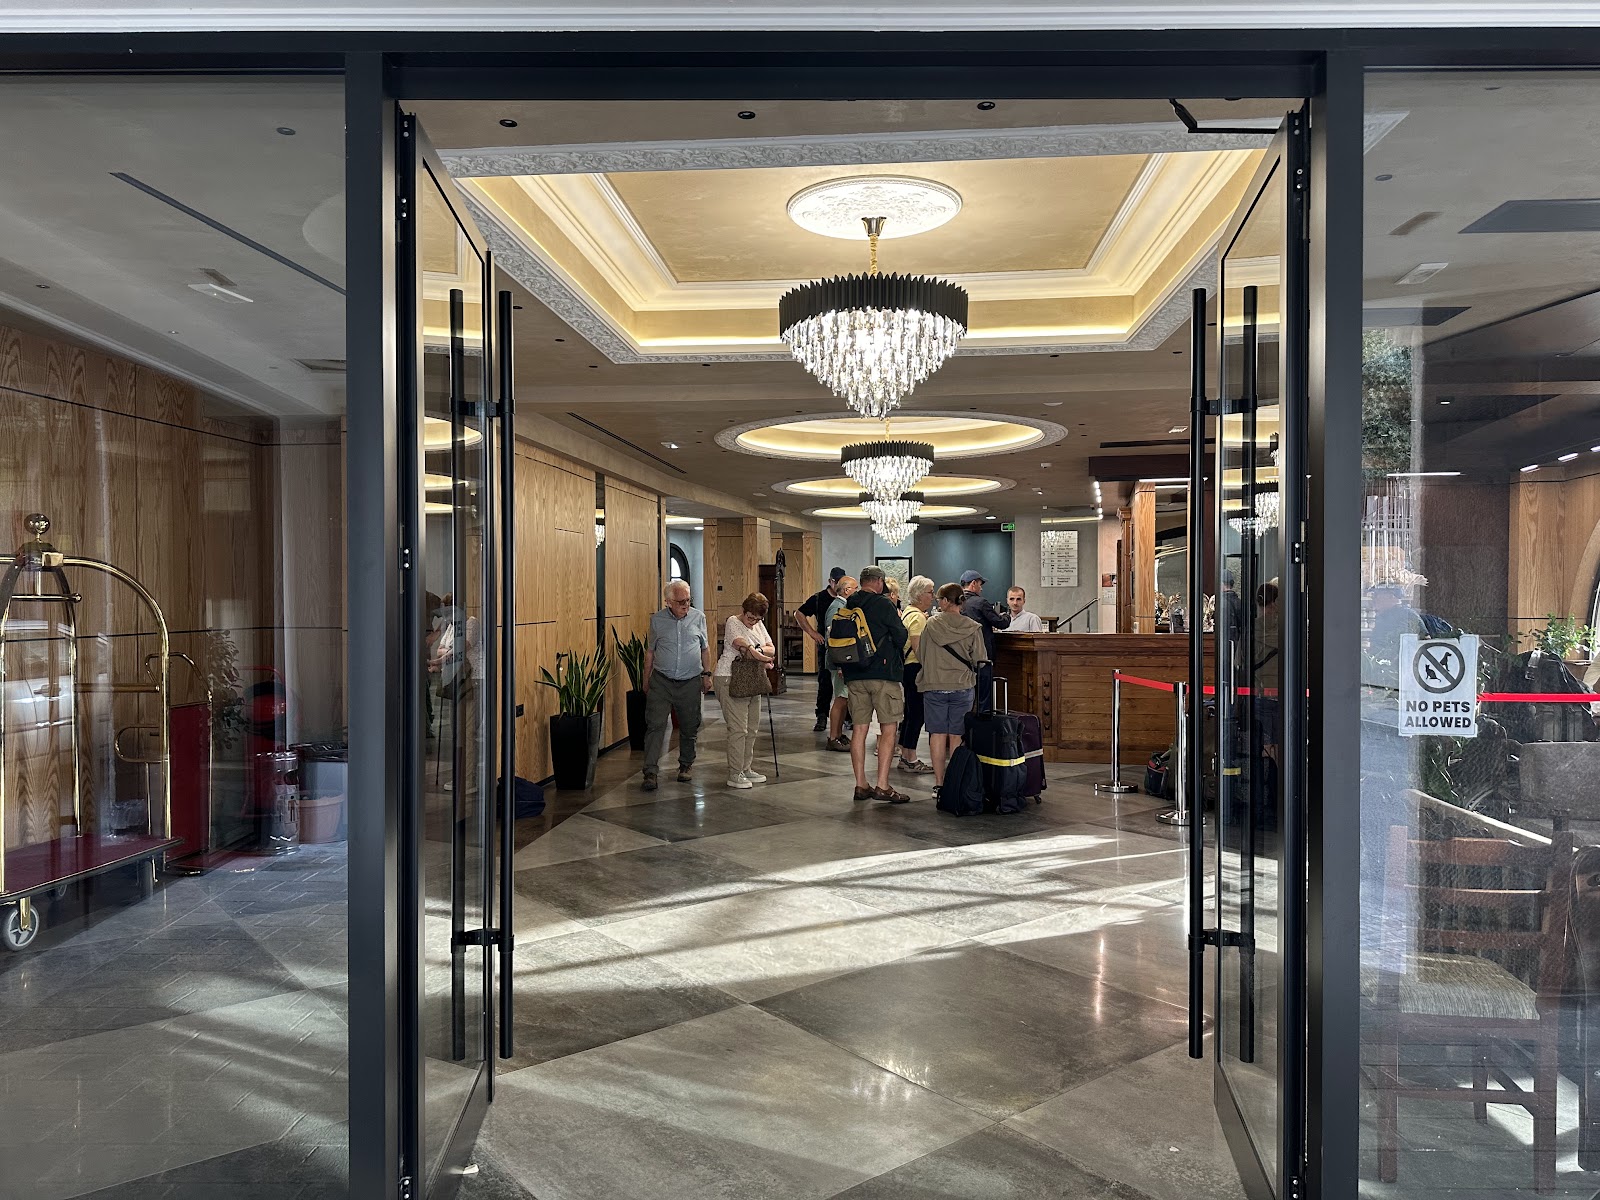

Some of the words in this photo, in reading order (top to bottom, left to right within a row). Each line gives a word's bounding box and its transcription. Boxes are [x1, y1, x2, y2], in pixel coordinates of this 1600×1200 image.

[1406, 700, 1428, 712] NO
[1432, 701, 1471, 713] PETS
[1404, 716, 1472, 728] ALLOWED
